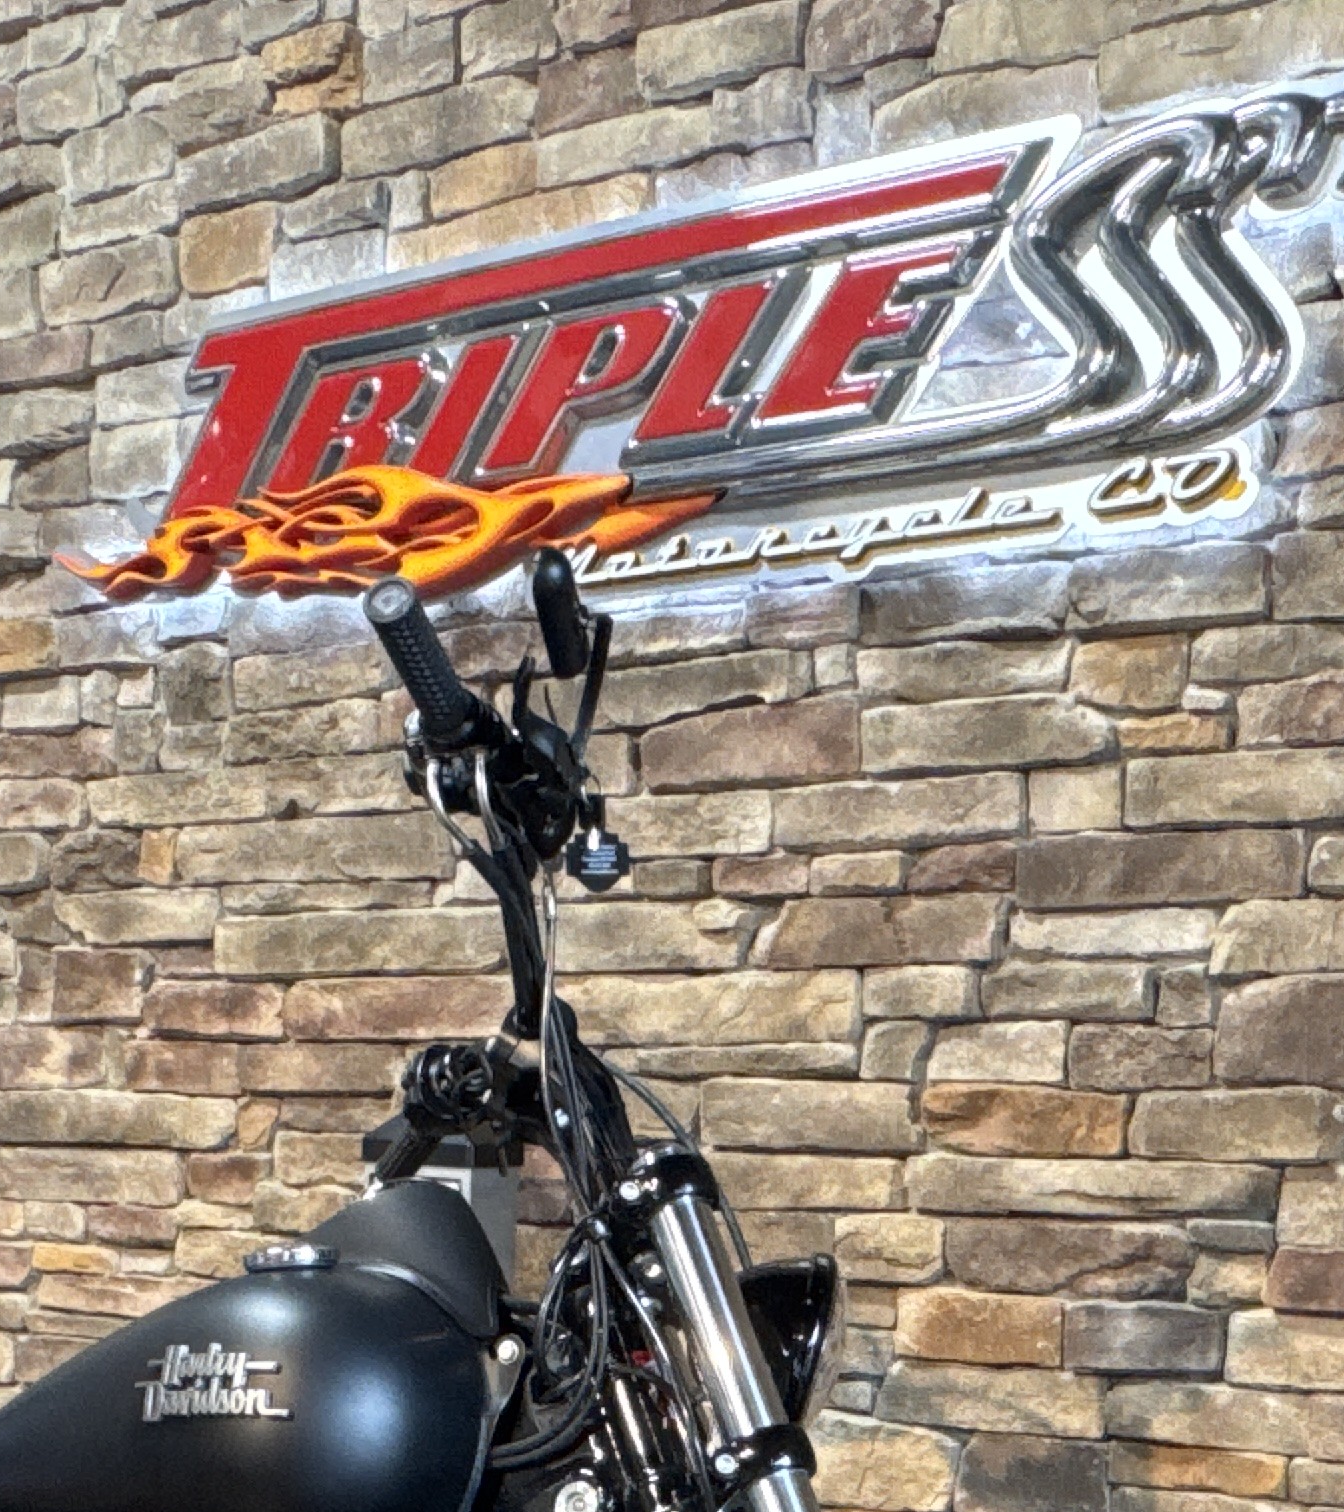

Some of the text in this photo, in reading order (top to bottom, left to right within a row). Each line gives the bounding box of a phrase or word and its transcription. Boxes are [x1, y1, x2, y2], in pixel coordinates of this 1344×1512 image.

[167, 138, 1048, 522] TRIPLE
[147, 1342, 282, 1388] Harley
[135, 1376, 291, 1422] Davidson
